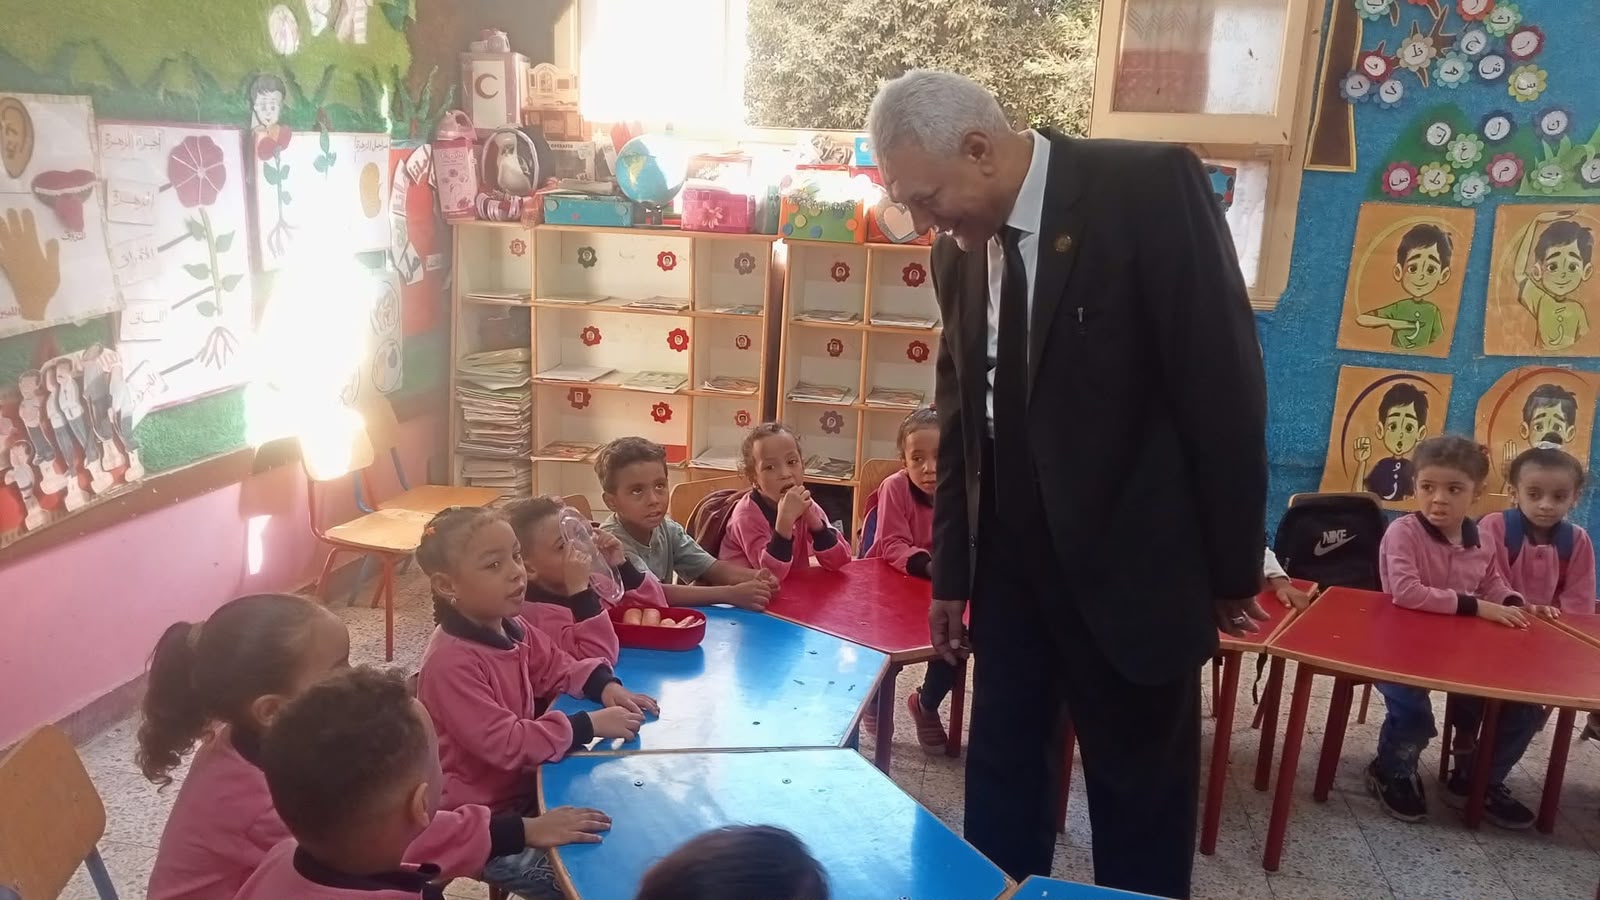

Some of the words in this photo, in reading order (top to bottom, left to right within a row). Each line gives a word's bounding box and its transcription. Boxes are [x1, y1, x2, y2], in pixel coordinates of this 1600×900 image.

[1491, 15, 1510, 25] ث
[1411, 44, 1424, 58] ظ
[1517, 41, 1530, 51] ر
[1481, 62, 1501, 75] ش
[1384, 82, 1397, 95] ذ
[1517, 82, 1536, 91] س
[1490, 121, 1502, 137] ل
[1547, 120, 1560, 131] ن
[1429, 172, 1441, 185] ط
[1498, 166, 1510, 180] م
[1391, 177, 1409, 187] ص
[1462, 184, 1478, 198] ي
[1323, 529, 1347, 544] NIKE
